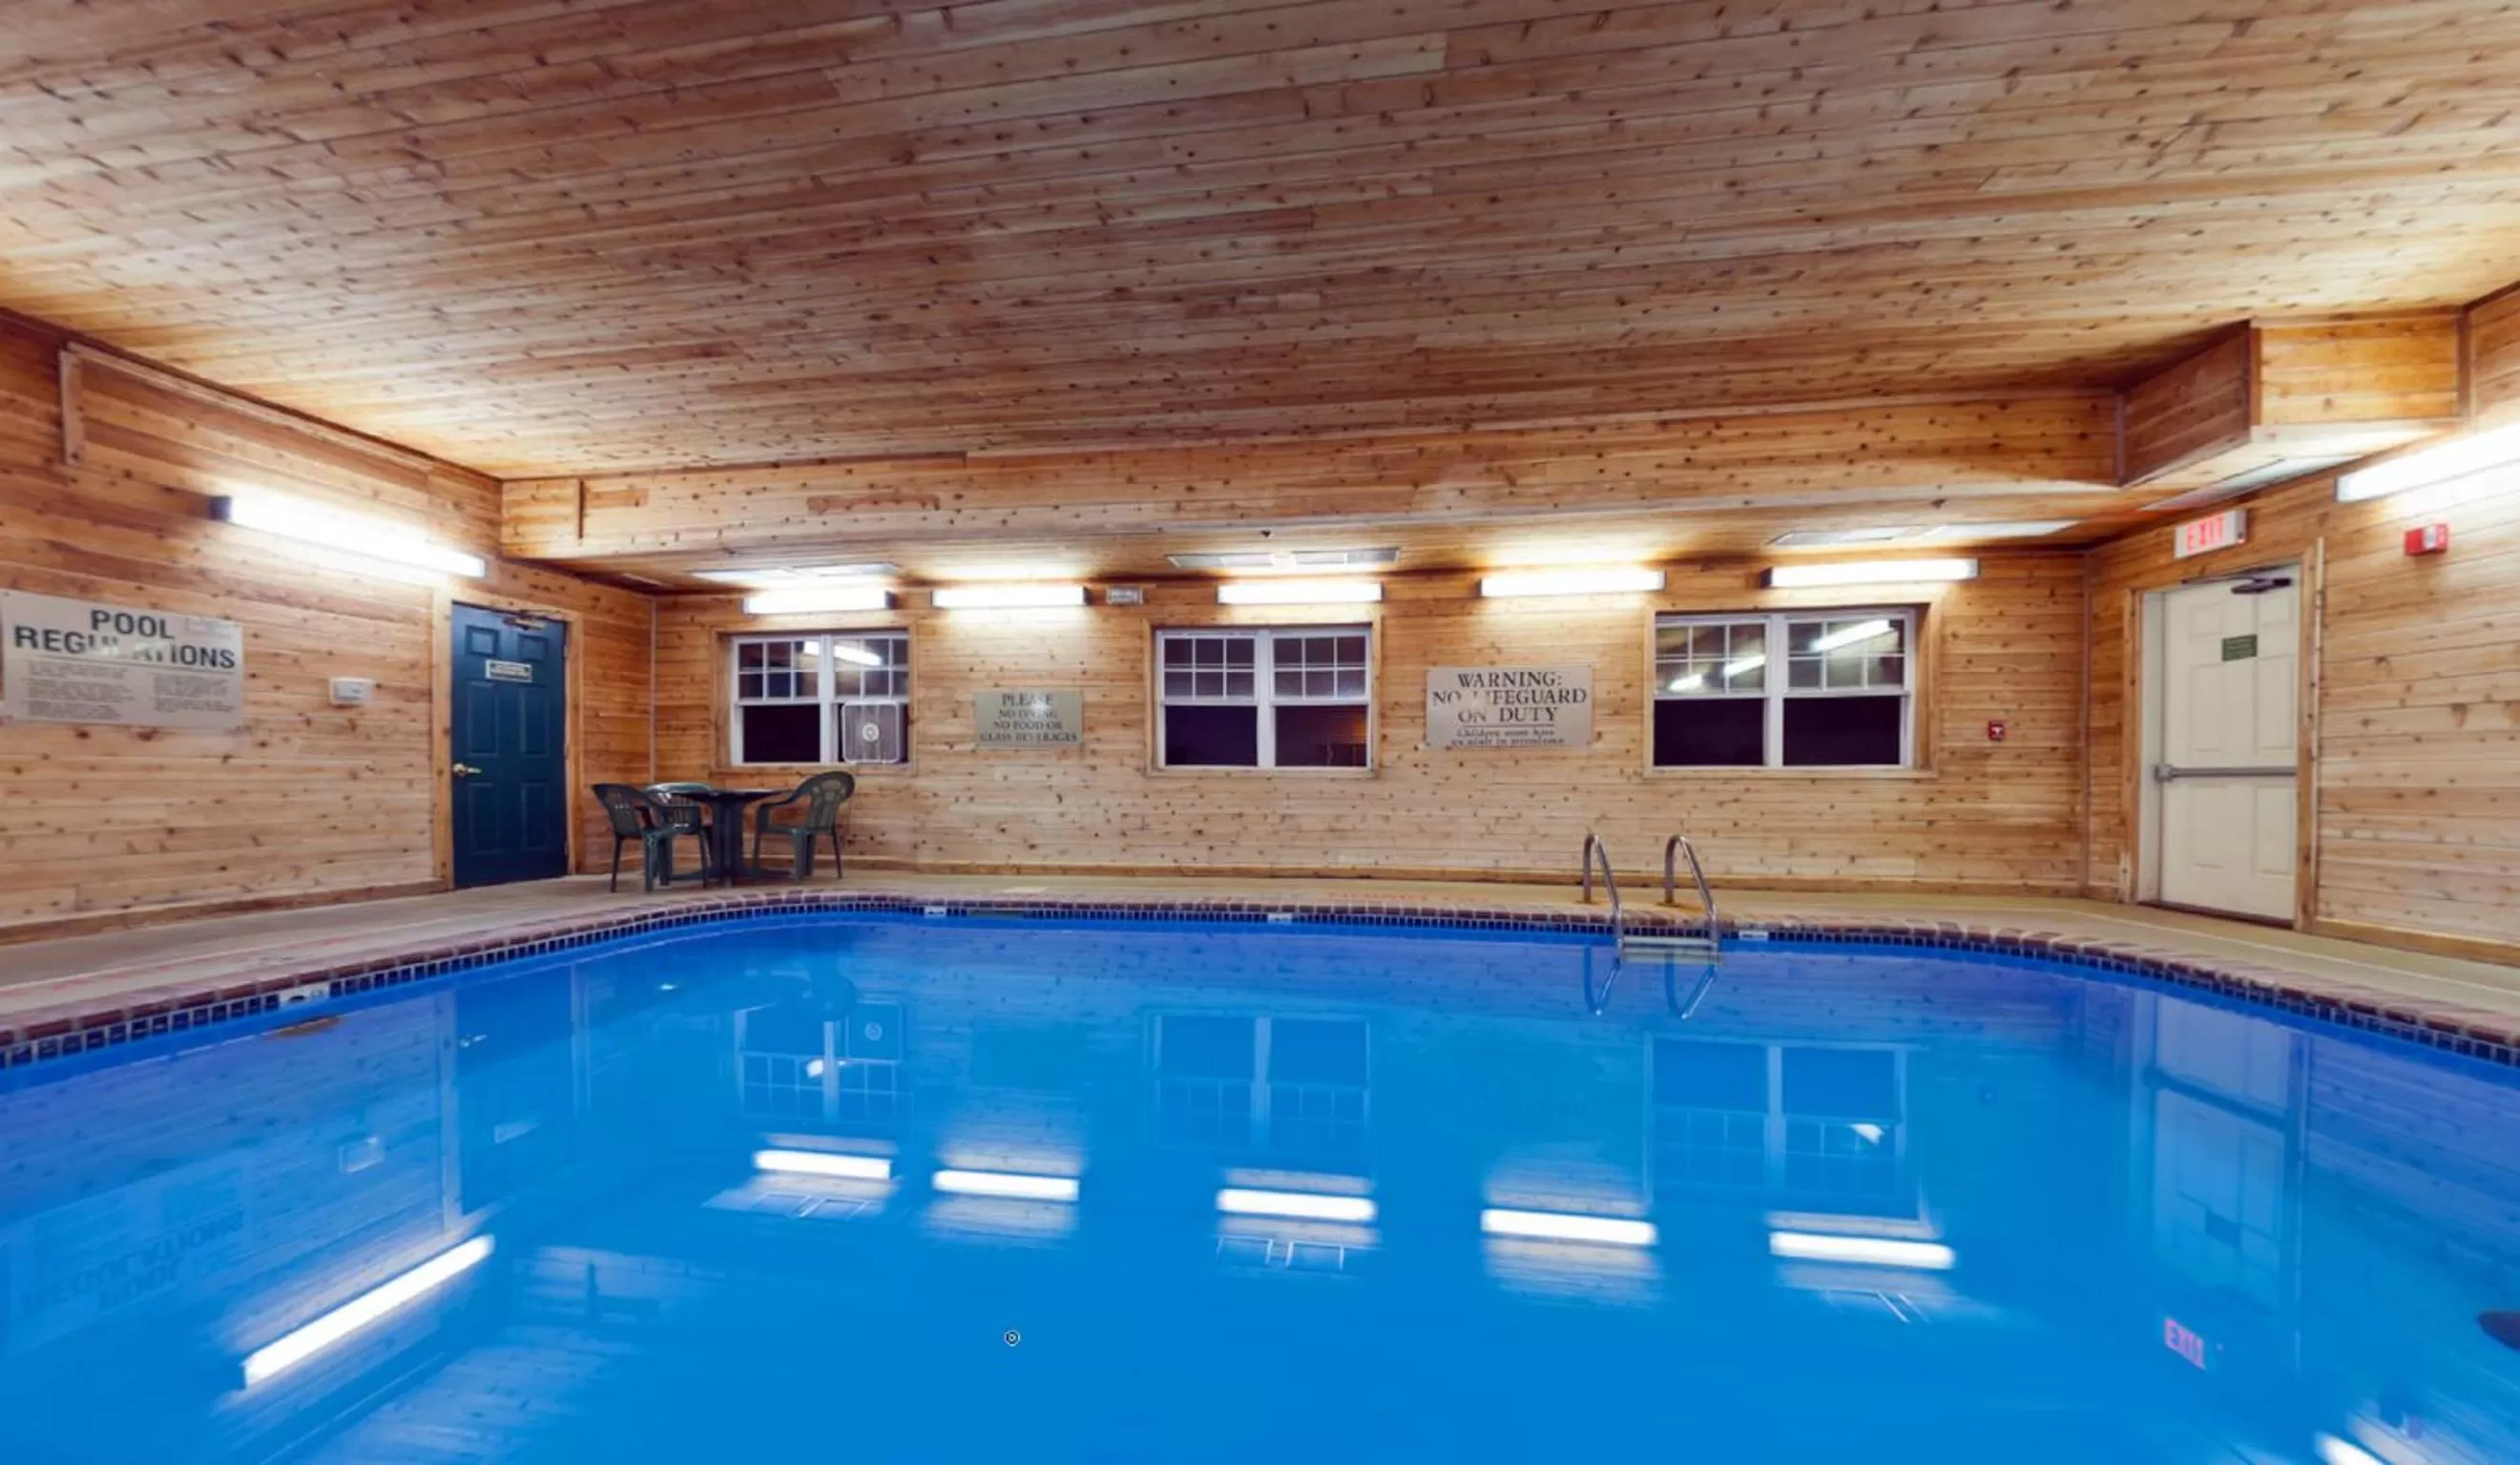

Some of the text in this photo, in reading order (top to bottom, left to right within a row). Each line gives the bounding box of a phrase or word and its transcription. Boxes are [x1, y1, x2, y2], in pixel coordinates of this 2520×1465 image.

[91, 609, 176, 638] POOL
[1457, 671, 1563, 687] WARNING:
[1001, 693, 1053, 706] PLEAE
[1432, 688, 1588, 706] NO FEGUARD
[1018, 709, 1058, 719] DIVNG
[1457, 706, 1558, 722] ON DUTY
[994, 721, 1010, 730] NO
